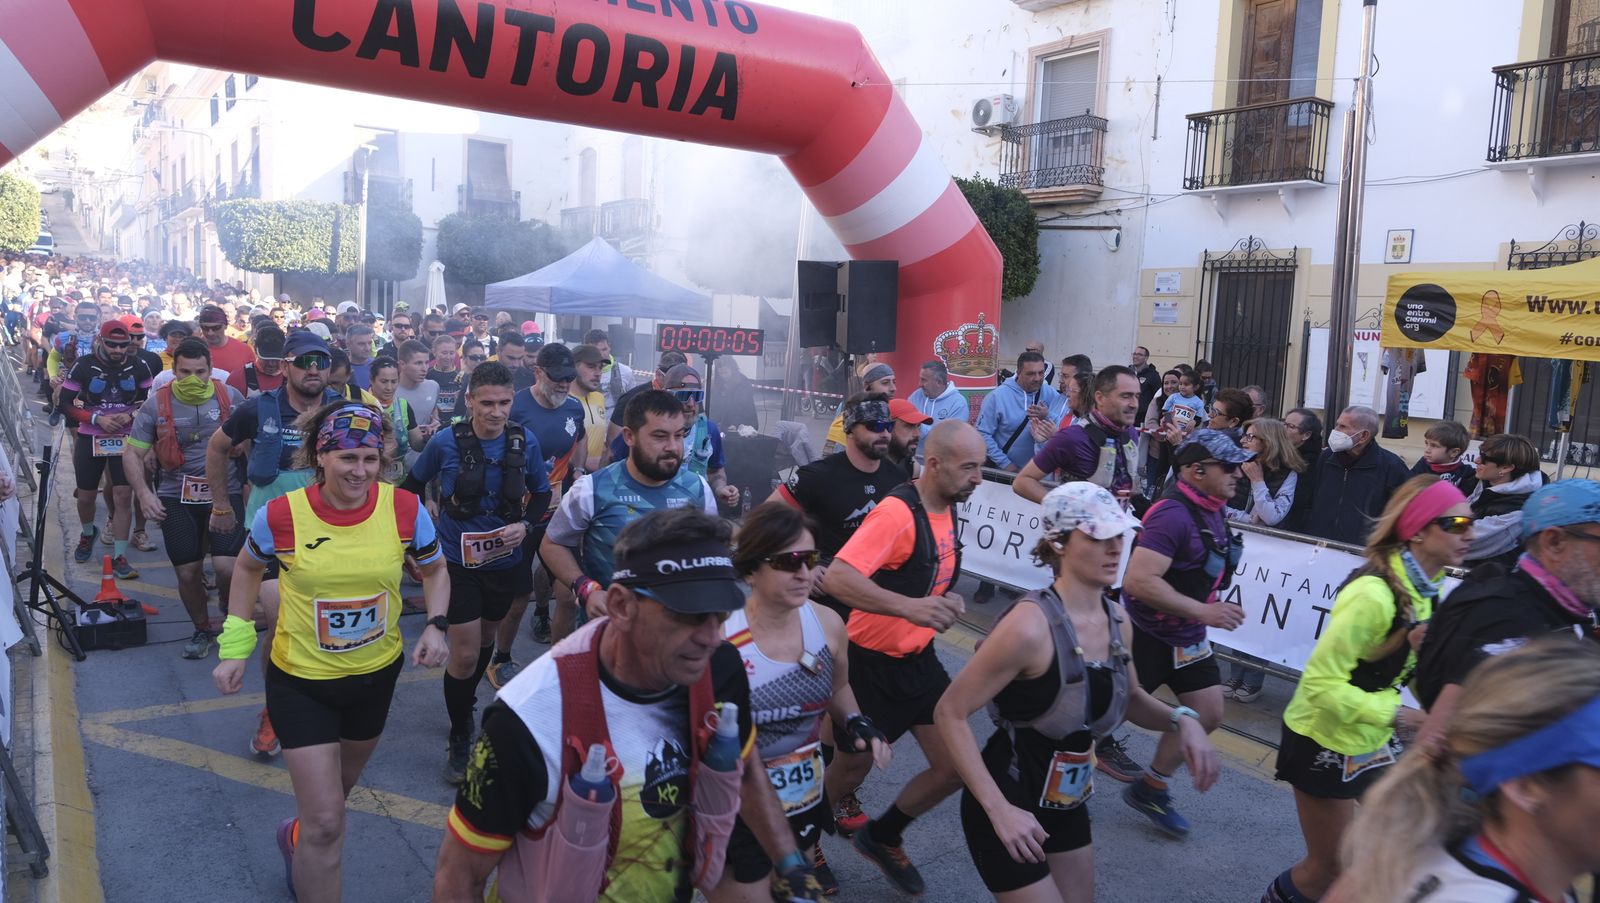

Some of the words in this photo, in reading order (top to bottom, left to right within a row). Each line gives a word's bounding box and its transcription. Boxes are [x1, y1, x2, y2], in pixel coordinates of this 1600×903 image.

[292, 0, 738, 120] CANTORIA
[661, 326, 760, 353] 00:00:05
[1354, 332, 1380, 341] NUN
[1403, 323, 1420, 331] .org
[764, 351, 785, 367] CHU
[100, 439, 123, 447] 230
[191, 483, 209, 493] 12
[962, 501, 1040, 530] MIENTO
[957, 517, 1025, 560] TOR
[1234, 562, 1342, 602] UNTAM
[329, 607, 376, 629] 371
[1222, 584, 1332, 640] ANT
[770, 761, 814, 790] 345
